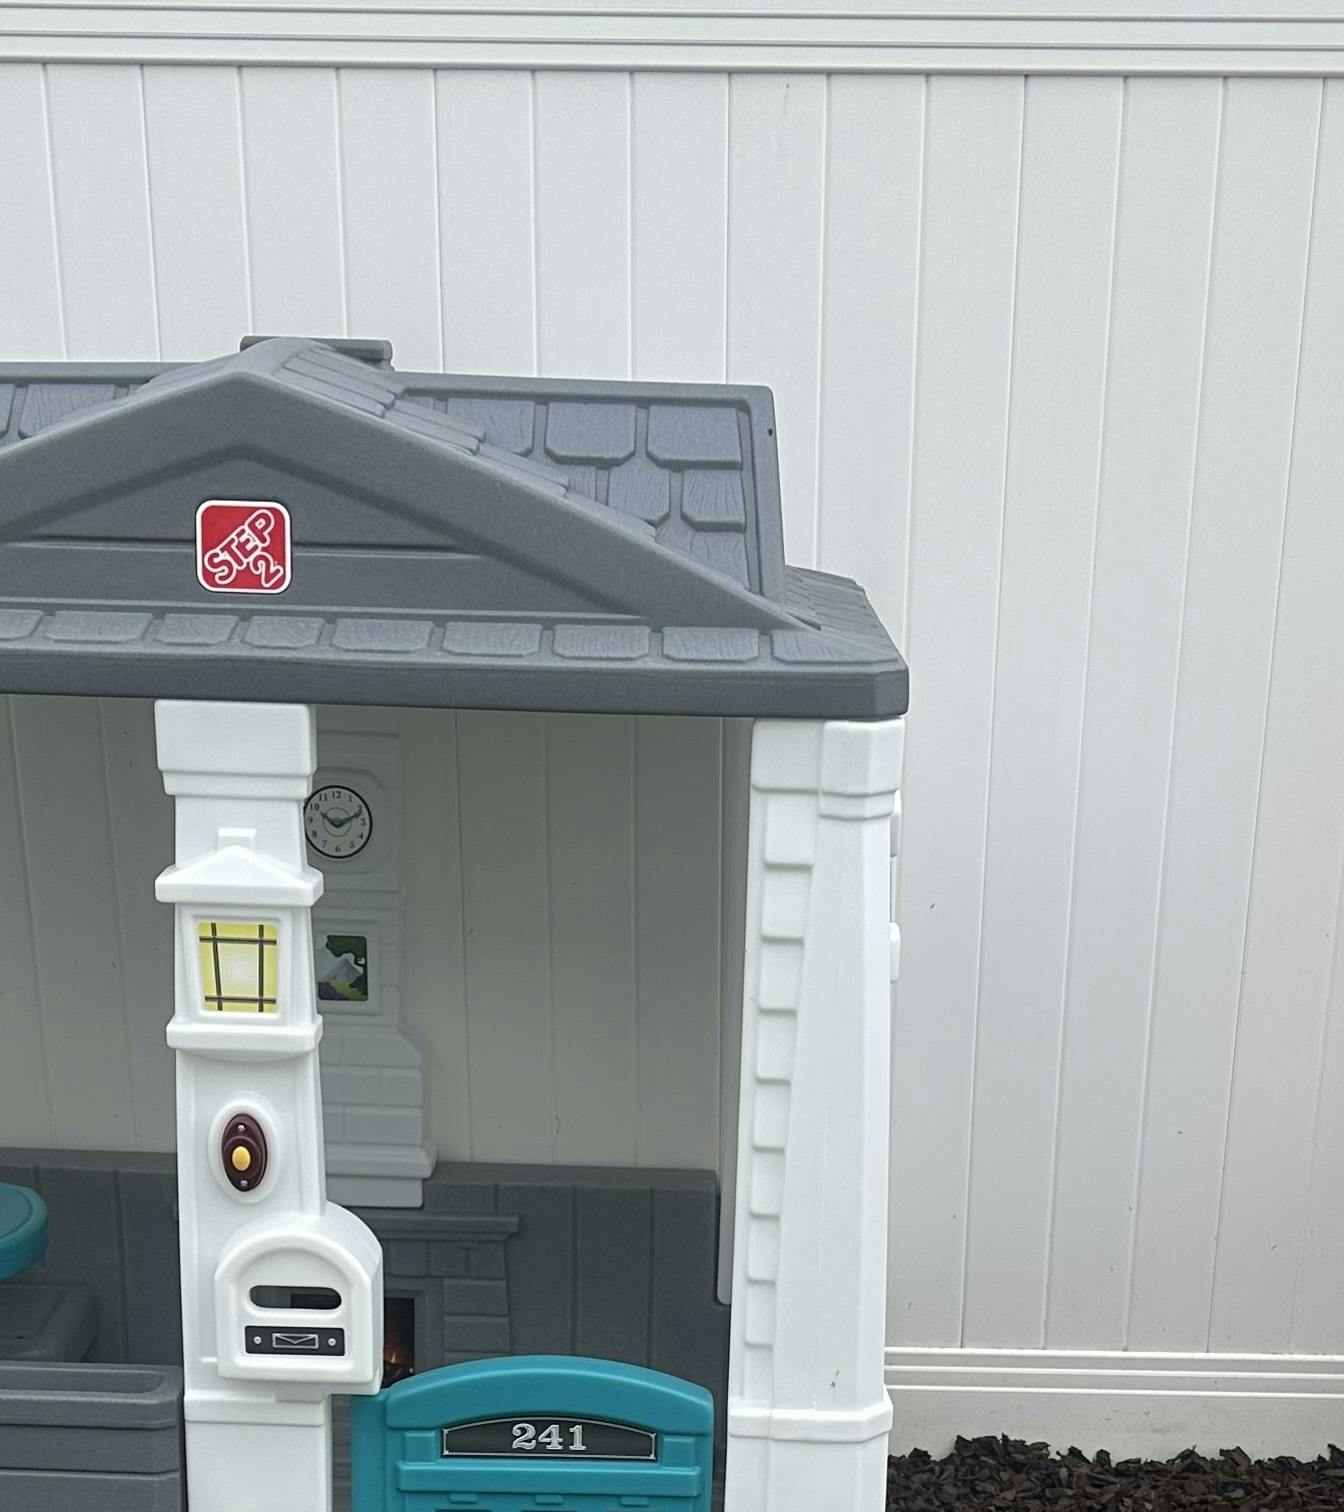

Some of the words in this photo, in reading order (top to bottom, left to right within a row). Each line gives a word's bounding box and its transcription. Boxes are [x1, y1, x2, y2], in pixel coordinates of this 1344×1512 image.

[203, 508, 275, 585] STEP
[249, 551, 284, 588] 2
[318, 793, 327, 802] 11
[332, 790, 342, 799] 12
[310, 803, 320, 812] 10
[334, 844, 342, 853] 6
[511, 1422, 587, 1452] 241
